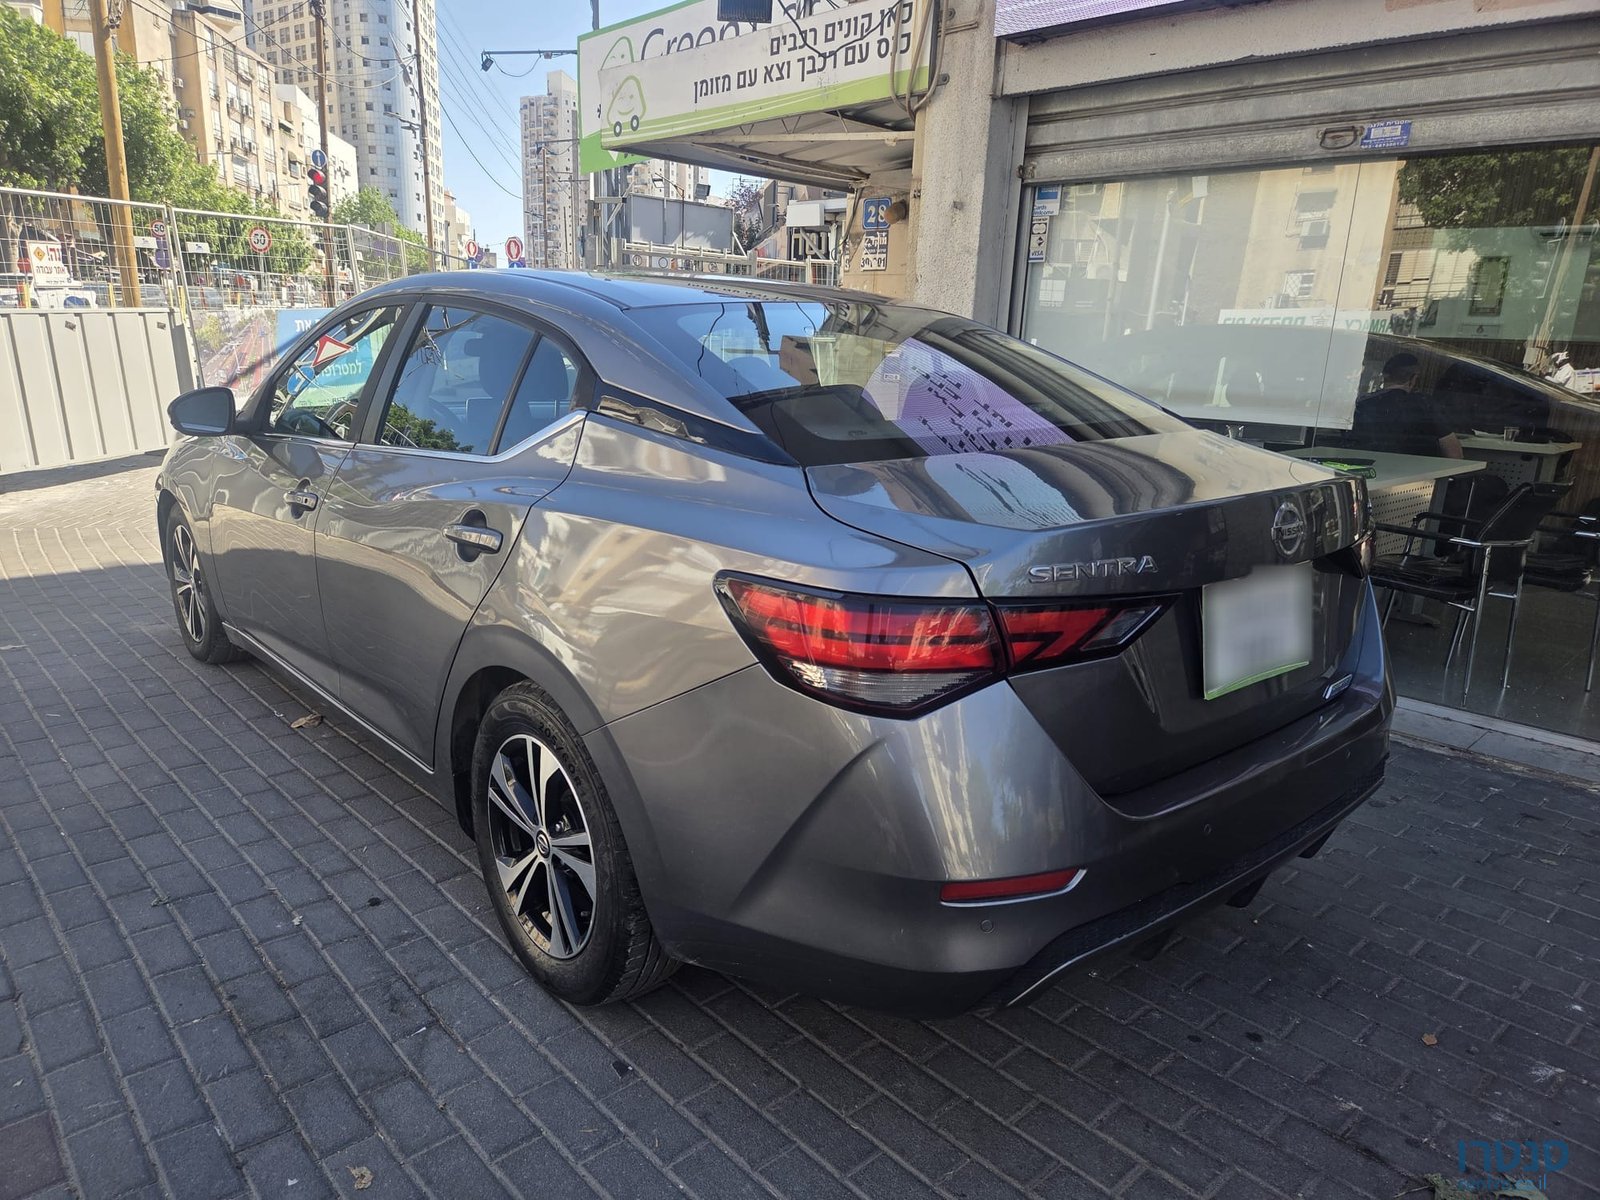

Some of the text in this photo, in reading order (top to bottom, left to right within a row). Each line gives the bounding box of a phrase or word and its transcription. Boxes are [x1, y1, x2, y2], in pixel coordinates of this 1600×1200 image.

[770, 2, 913, 56] כאן קונים רכבים
[694, 33, 911, 103] כס עם רכבך וצא עם מזומן
[867, 205, 887, 223] 28
[154, 224, 165, 233] 50
[253, 233, 266, 245] 50
[36, 265, 53, 274] עבודה
[1028, 555, 1158, 583] SENTRA
